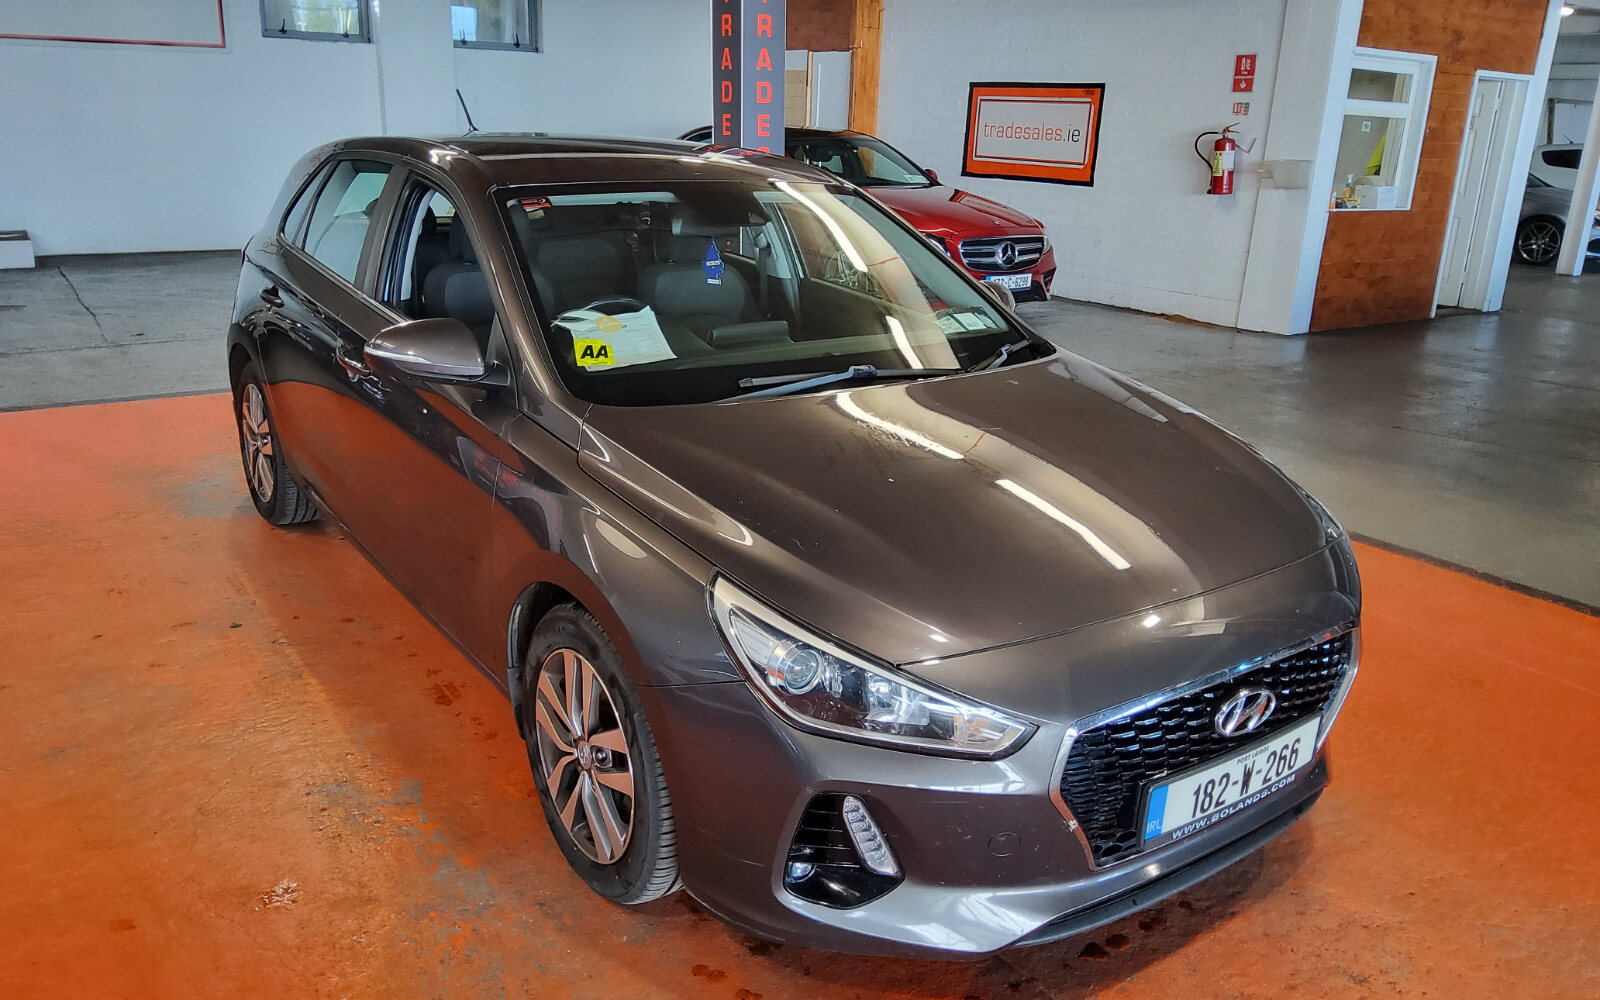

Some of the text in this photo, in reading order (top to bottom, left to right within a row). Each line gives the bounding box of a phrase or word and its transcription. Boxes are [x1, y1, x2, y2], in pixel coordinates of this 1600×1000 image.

[720, 0, 733, 136] RADE
[984, 122, 1080, 142] tradesales.ie
[580, 345, 608, 359] AA
[1237, 753, 1251, 765] PORT
[1191, 737, 1302, 819] 182-W-266
[1172, 773, 1296, 840] WWW.BOLANDS.COM
[1146, 819, 1162, 834] IRL
